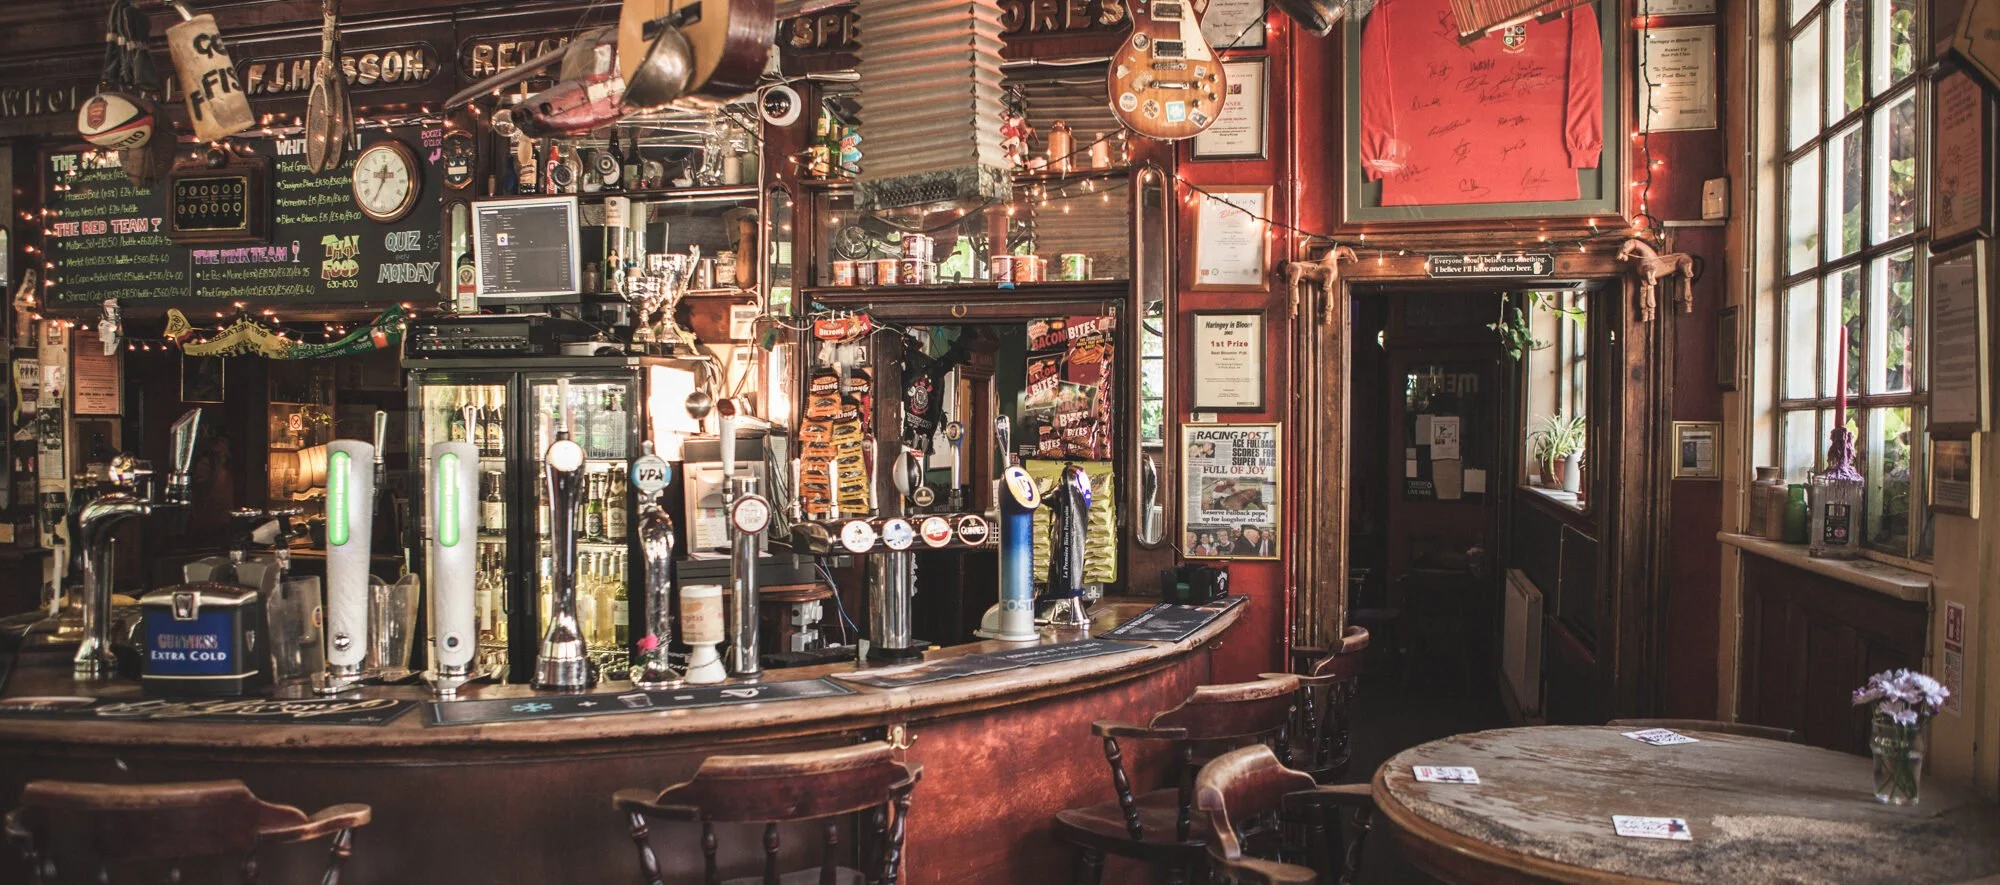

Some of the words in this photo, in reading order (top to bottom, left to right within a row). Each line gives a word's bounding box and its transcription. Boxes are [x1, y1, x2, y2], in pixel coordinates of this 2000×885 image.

[51, 154, 78, 172] THE
[54, 222, 80, 237] THE
[82, 220, 107, 234] RED
[110, 218, 148, 234] TEAM
[321, 234, 360, 260] THAI
[385, 230, 422, 253] QUIZ
[193, 249, 220, 264] THE
[220, 248, 250, 264] PINK
[250, 246, 288, 263] TEAM
[321, 259, 360, 280] FOOD
[377, 262, 440, 284] MONDAY
[1516, 264, 1532, 272] beer.
[1068, 319, 1096, 340] BITES
[1206, 321, 1229, 330] Haringey
[1032, 332, 1066, 349] BACON
[1032, 374, 1058, 396] BITES
[1196, 431, 1238, 440] RACING
[1240, 431, 1269, 440] POST
[1039, 438, 1060, 451] BITES
[1232, 439, 1244, 448] ACE
[1232, 448, 1260, 457] SCORES
[1232, 458, 1256, 466] SUPER
[639, 468, 664, 481] VPA
[1203, 466, 1228, 474] FULL
[1230, 466, 1244, 474] OF
[1246, 466, 1266, 474] JOY
[151, 650, 186, 661] EXTRA
[190, 650, 227, 661] COLD
